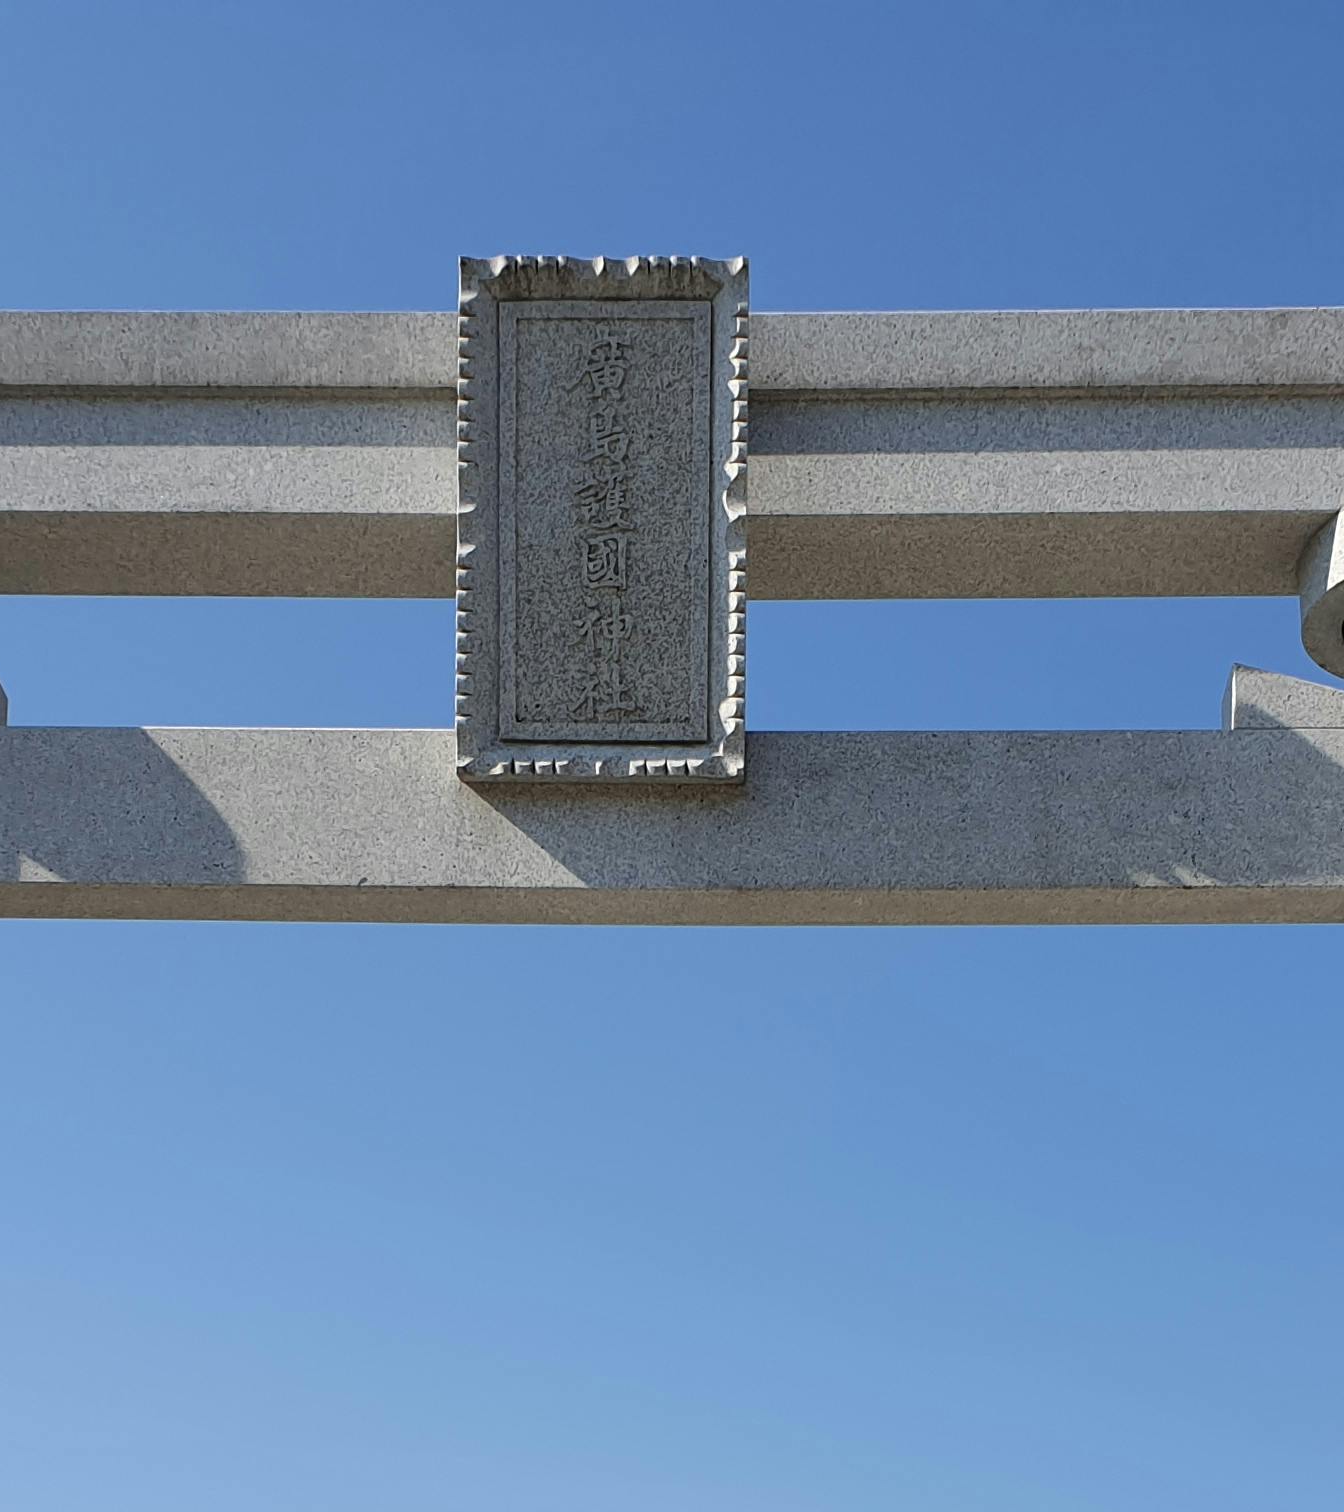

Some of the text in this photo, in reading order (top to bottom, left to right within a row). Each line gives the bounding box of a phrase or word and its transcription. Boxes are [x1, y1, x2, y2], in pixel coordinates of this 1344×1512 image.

[565, 326, 636, 720] 廣島護國神社
